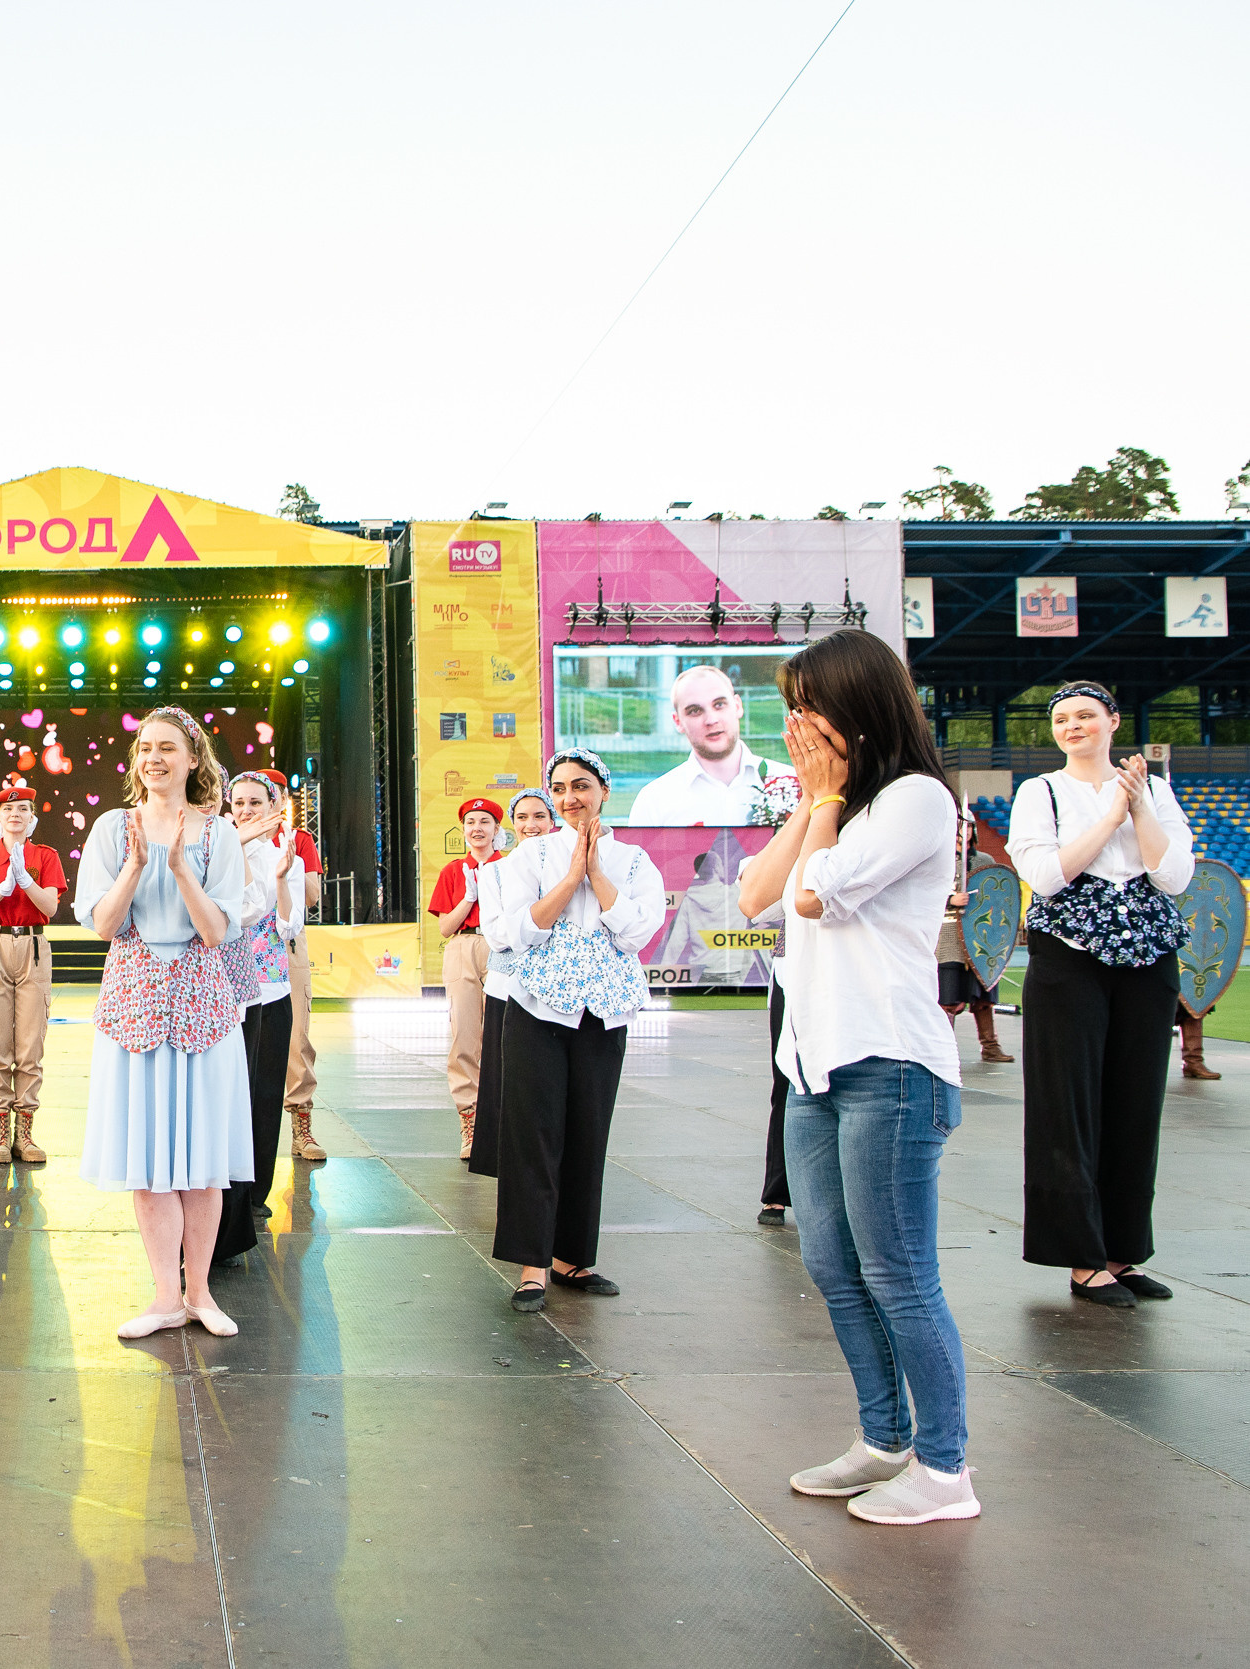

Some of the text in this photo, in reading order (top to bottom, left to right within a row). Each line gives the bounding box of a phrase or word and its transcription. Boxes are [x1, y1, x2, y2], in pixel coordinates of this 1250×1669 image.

[451, 548, 493, 561] RU TV
[1153, 746, 1162, 758] 6
[448, 837, 461, 846] ЦЕХ
[713, 933, 776, 946] ОТКРЫ
